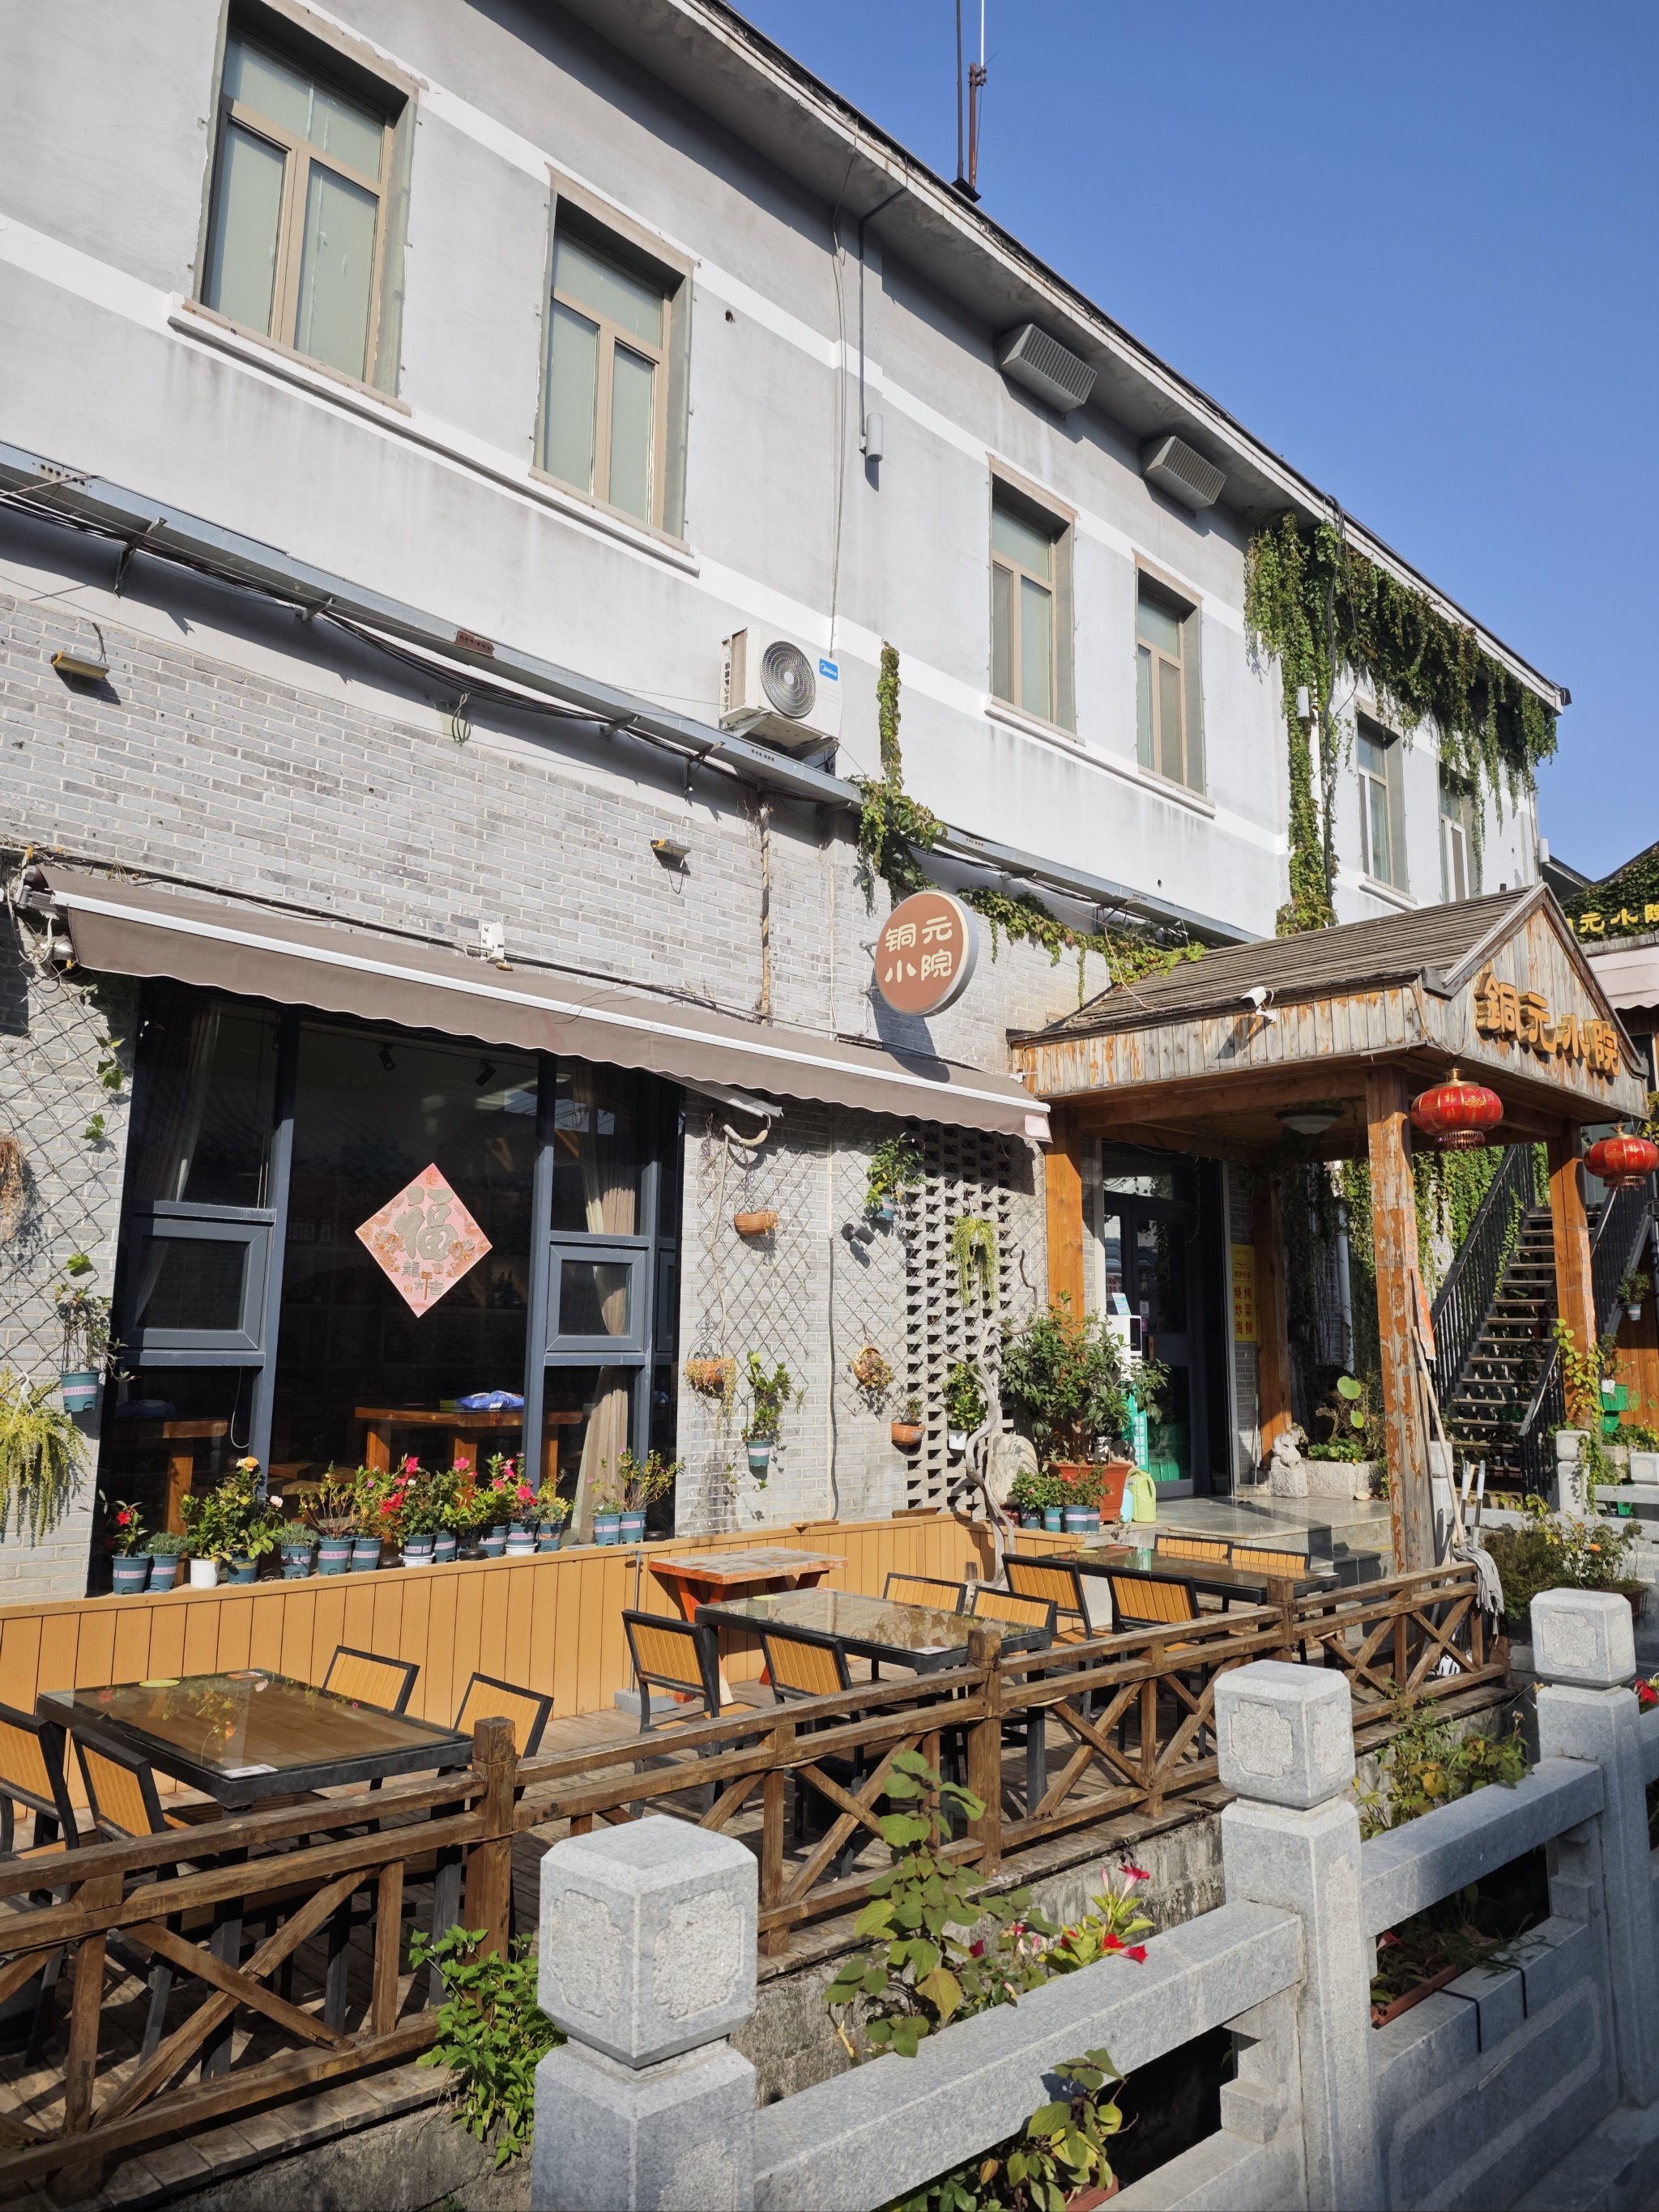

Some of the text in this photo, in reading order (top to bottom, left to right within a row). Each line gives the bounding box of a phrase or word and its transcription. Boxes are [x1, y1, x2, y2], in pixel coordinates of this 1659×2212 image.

[820, 663, 838, 677] Midea
[885, 915, 953, 953] 铜元
[884, 948, 953, 983] 小院
[393, 1186, 458, 1262] 福
[1234, 1285, 1252, 1301] 烧烤
[1235, 1303, 1252, 1317] 炒菜
[1235, 1321, 1253, 1336] 海鲜
